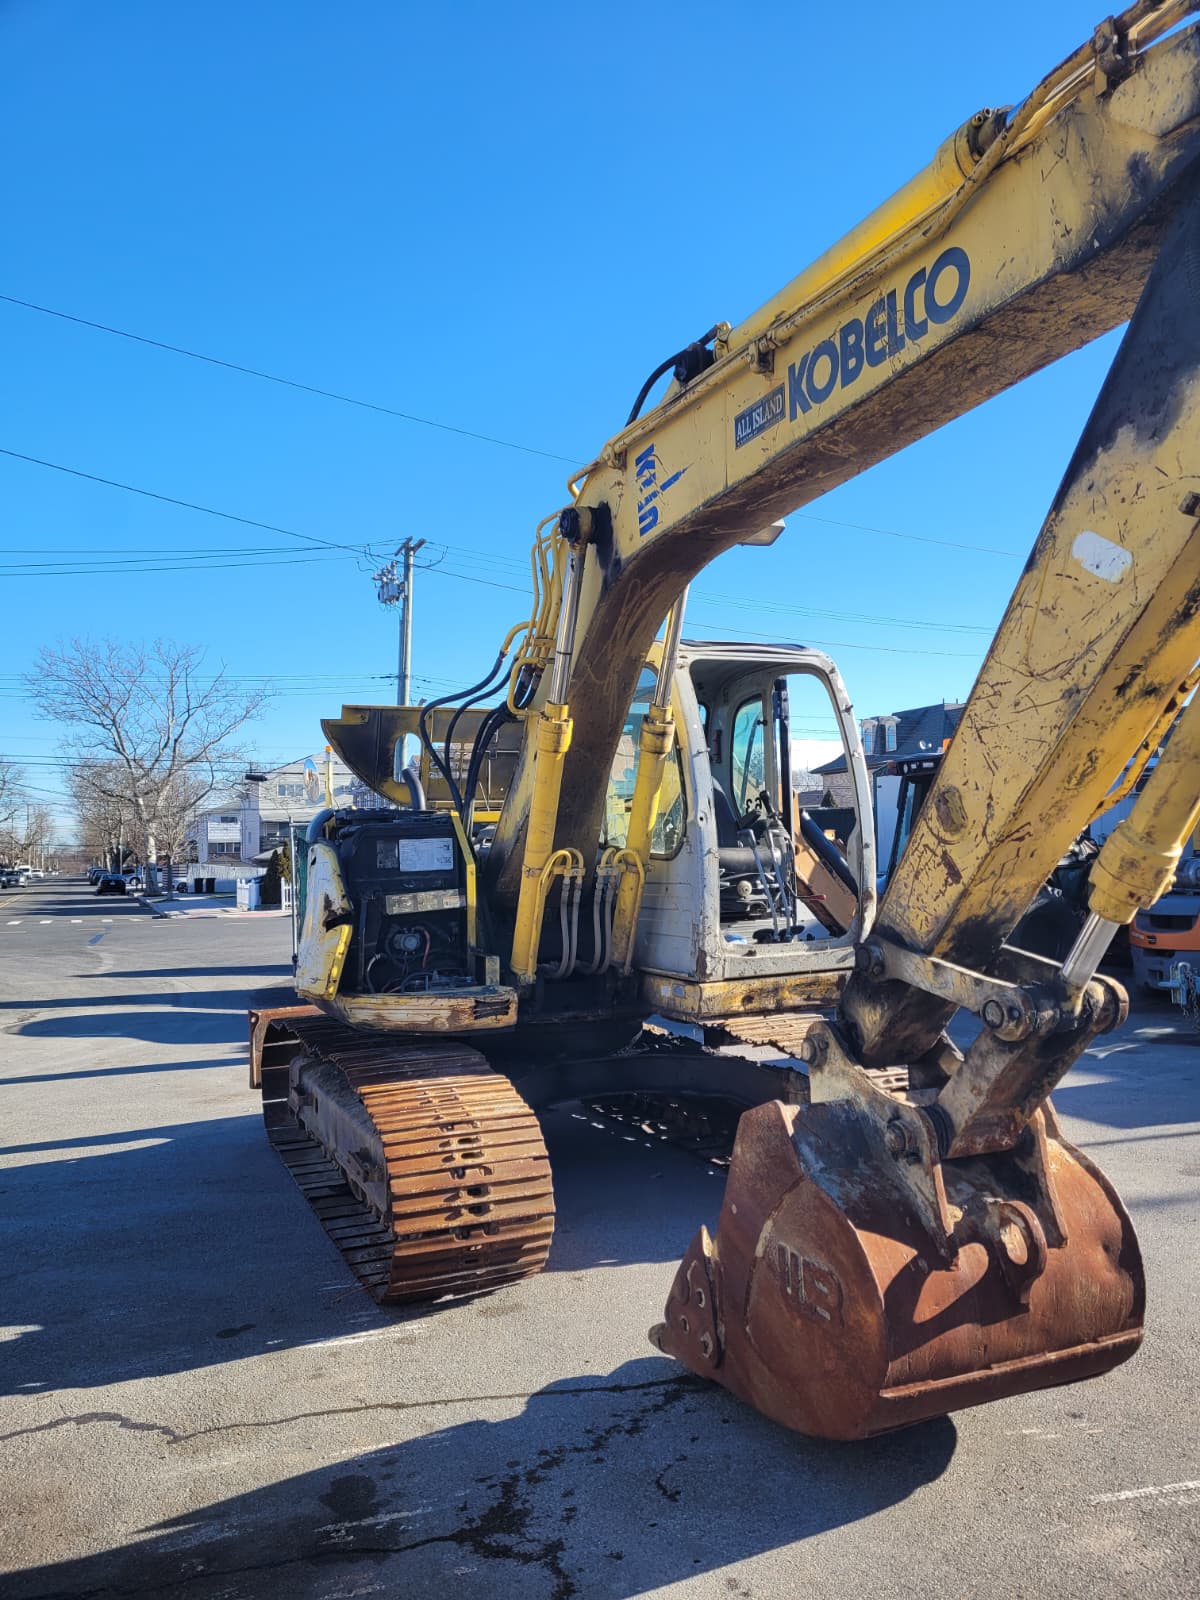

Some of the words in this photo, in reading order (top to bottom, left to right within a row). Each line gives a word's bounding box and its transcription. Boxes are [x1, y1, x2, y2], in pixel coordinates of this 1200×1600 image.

[787, 246, 971, 422] KOBELCO
[736, 415, 752, 441] ALL
[752, 394, 783, 430] ISLAND
